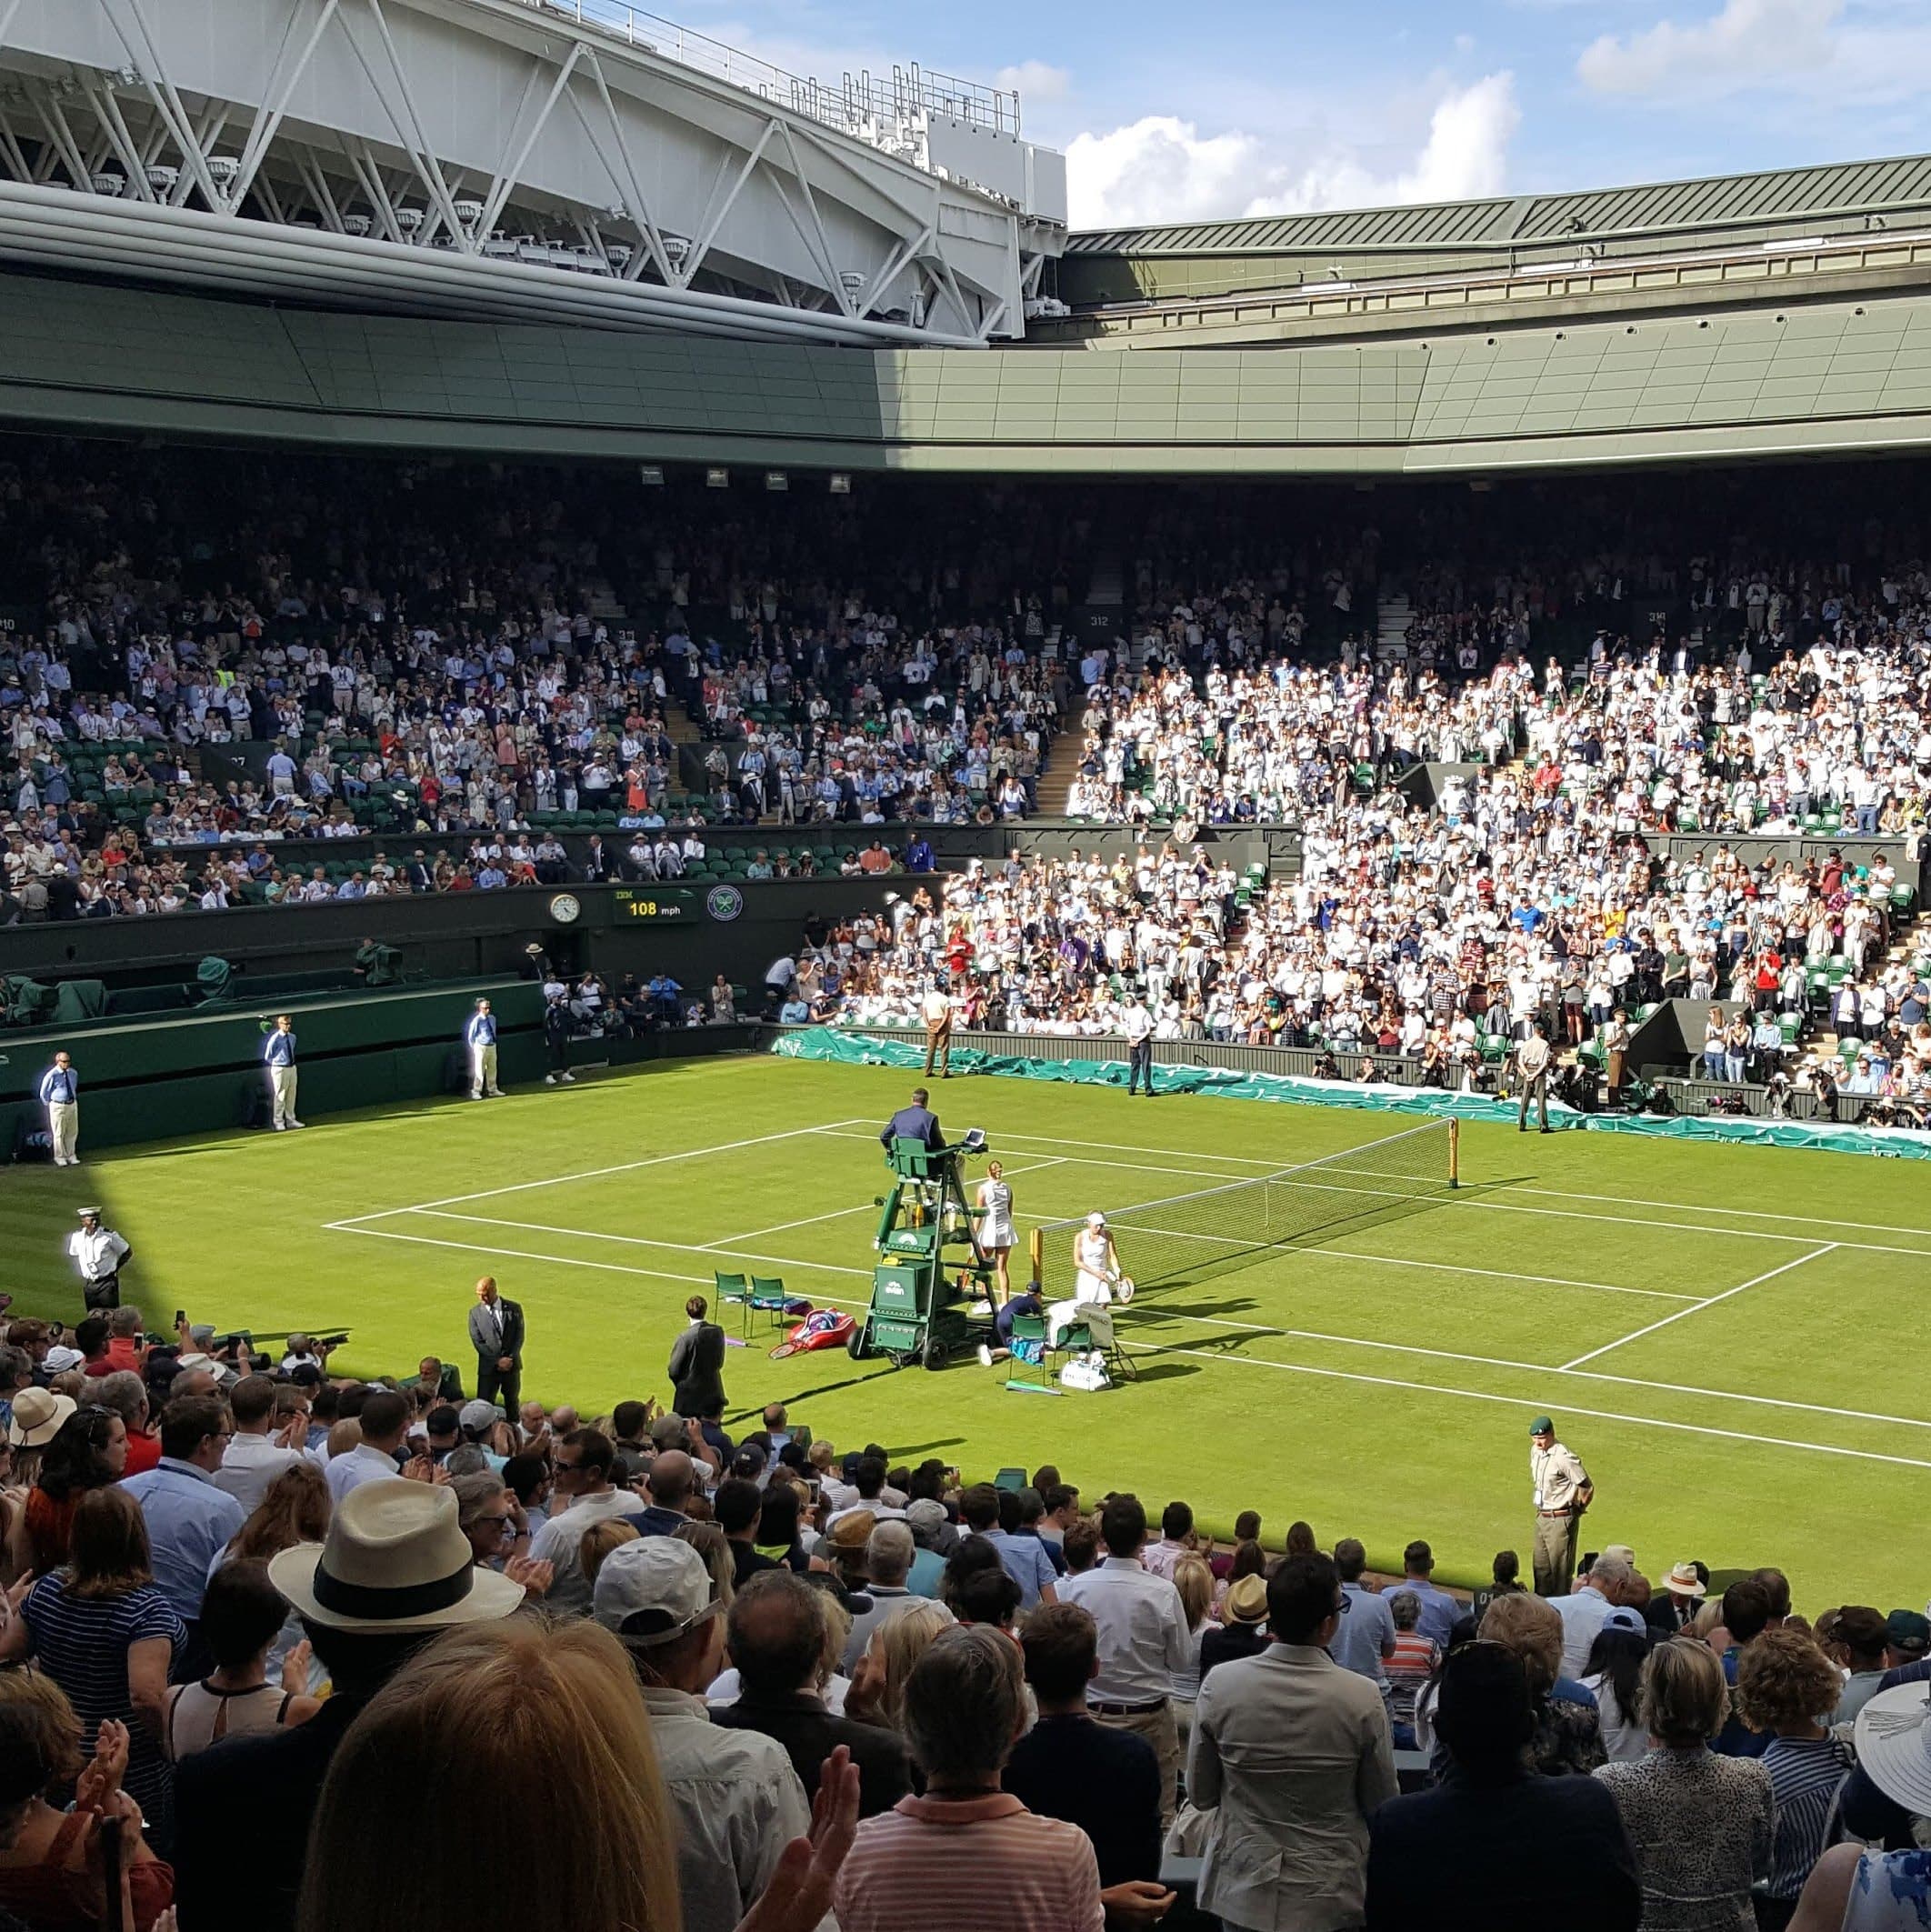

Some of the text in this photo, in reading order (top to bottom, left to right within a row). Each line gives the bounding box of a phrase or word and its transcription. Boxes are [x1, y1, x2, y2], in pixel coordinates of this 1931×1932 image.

[1090, 616, 1109, 626] 312
[629, 902, 681, 916] 108 mph
